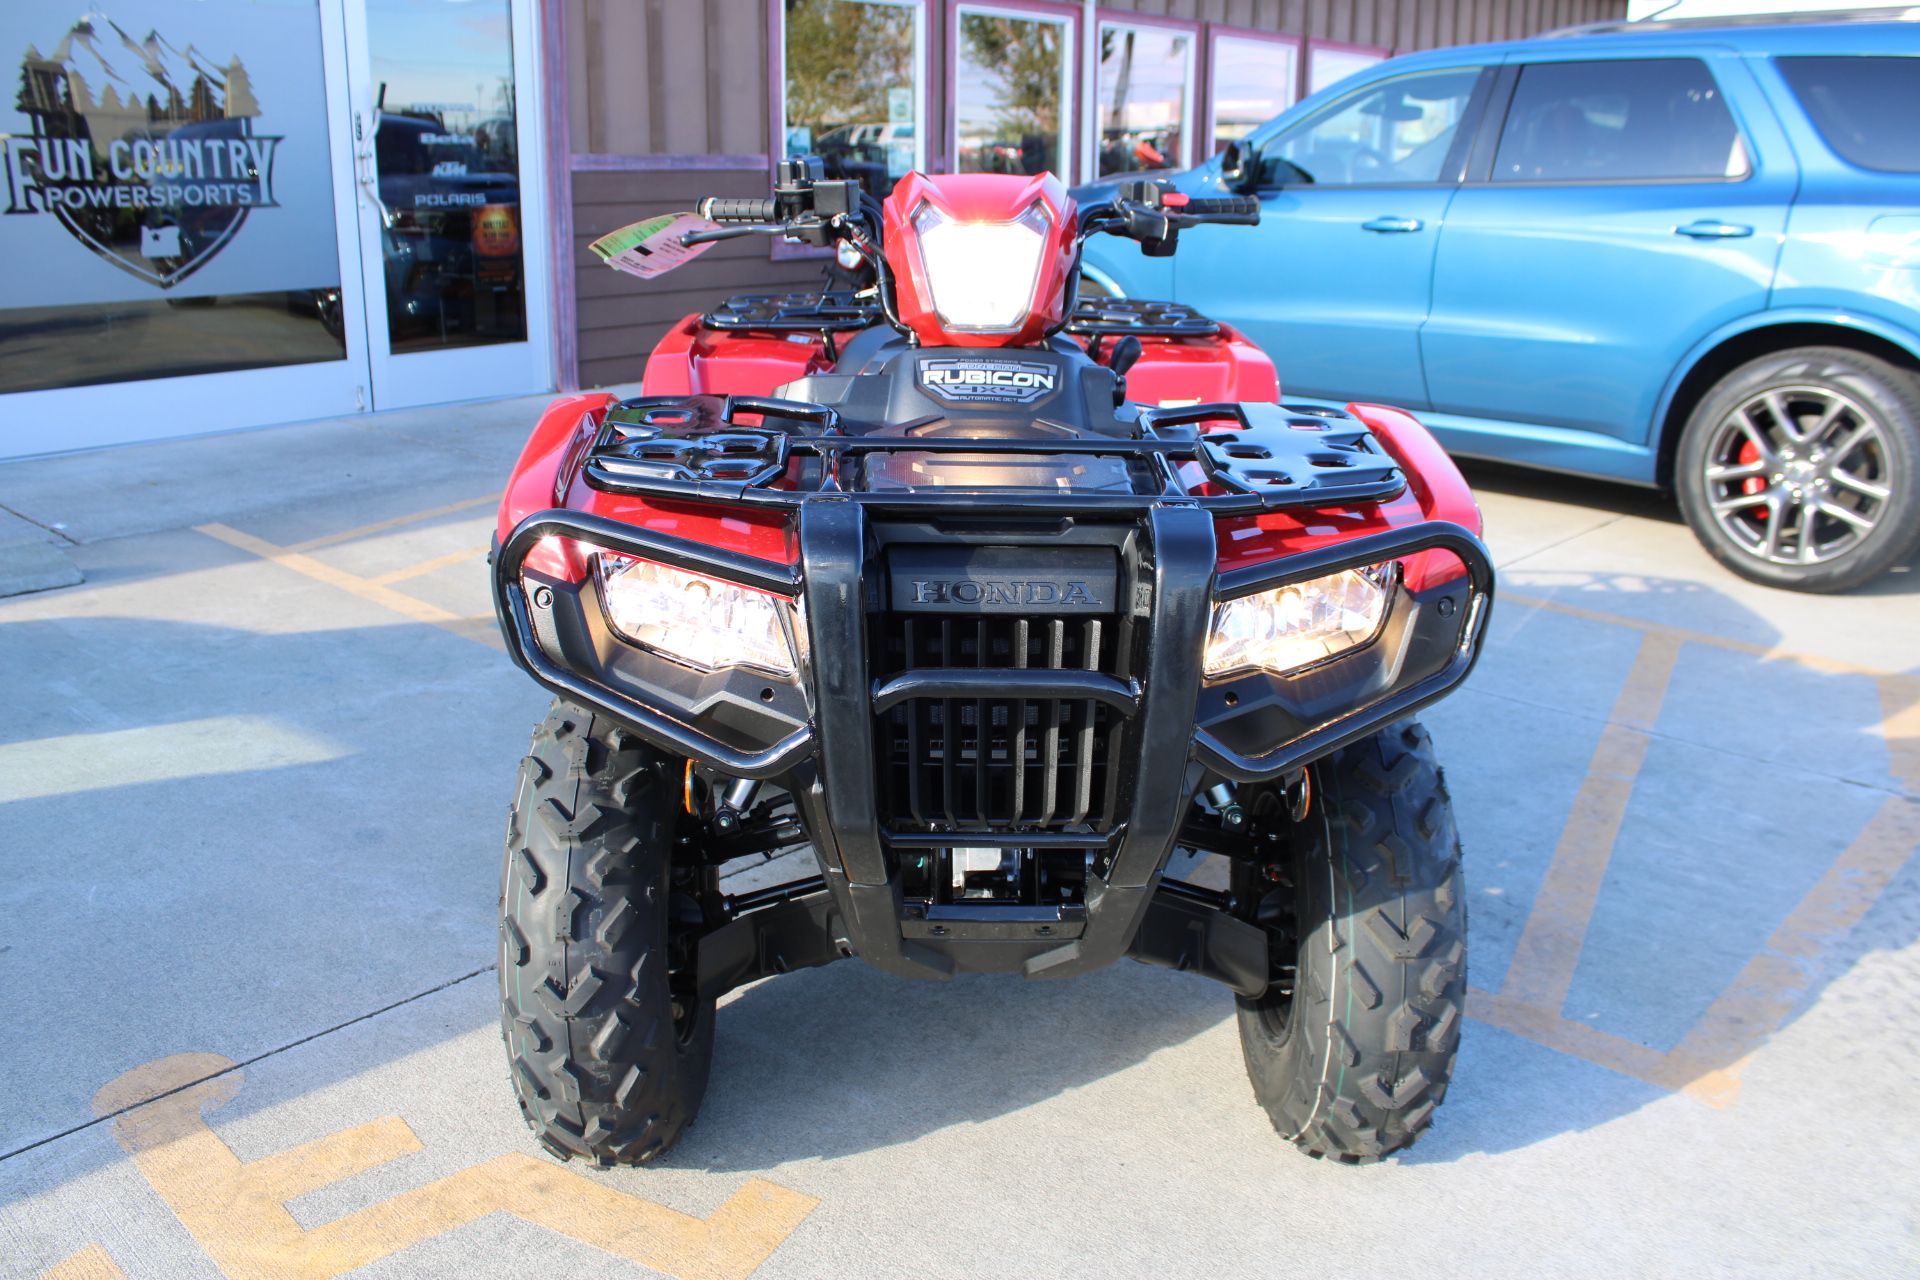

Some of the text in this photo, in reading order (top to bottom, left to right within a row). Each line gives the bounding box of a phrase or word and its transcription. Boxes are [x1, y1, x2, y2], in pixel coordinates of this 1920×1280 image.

[420, 132, 475, 145] Beta
[3, 137, 282, 213] FUN COUNTRY
[49, 183, 252, 209] POWERSPORTS
[414, 192, 487, 206] POLARIS
[923, 370, 1054, 389] RUBICON
[911, 580, 1102, 605] HONDA
